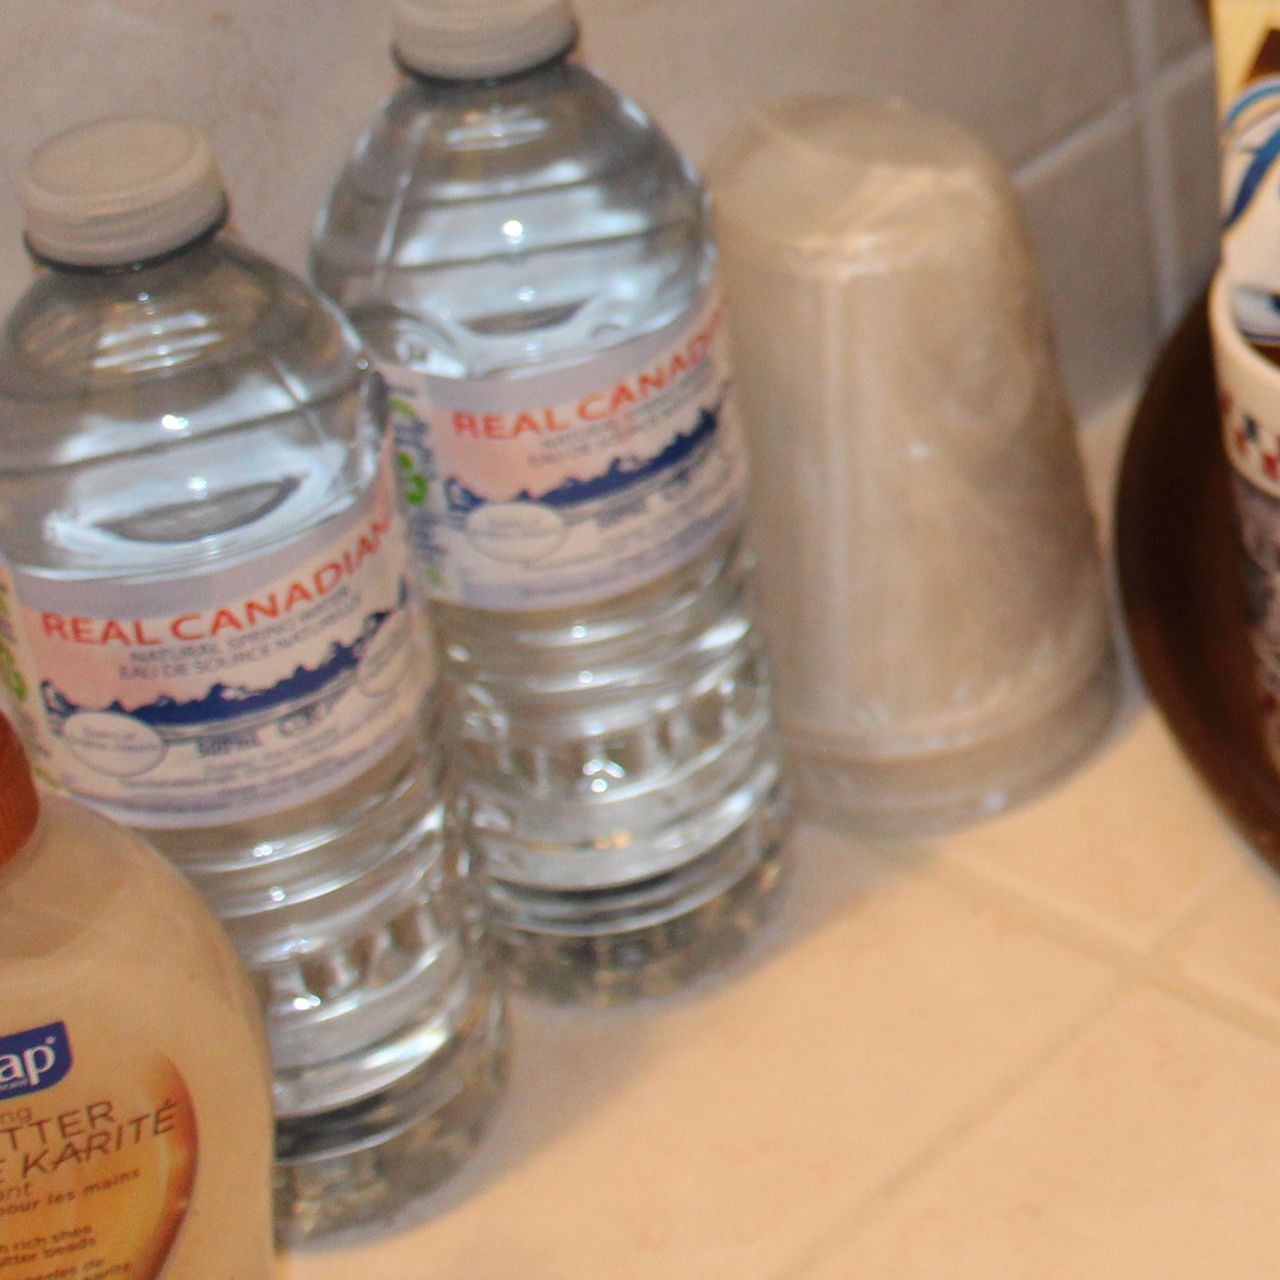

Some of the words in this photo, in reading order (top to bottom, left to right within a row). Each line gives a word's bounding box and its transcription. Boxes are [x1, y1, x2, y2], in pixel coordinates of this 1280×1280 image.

[453, 409, 570, 440] REAL
[40, 611, 163, 647] REAL
[21, 1097, 178, 1179] KARITÉ
